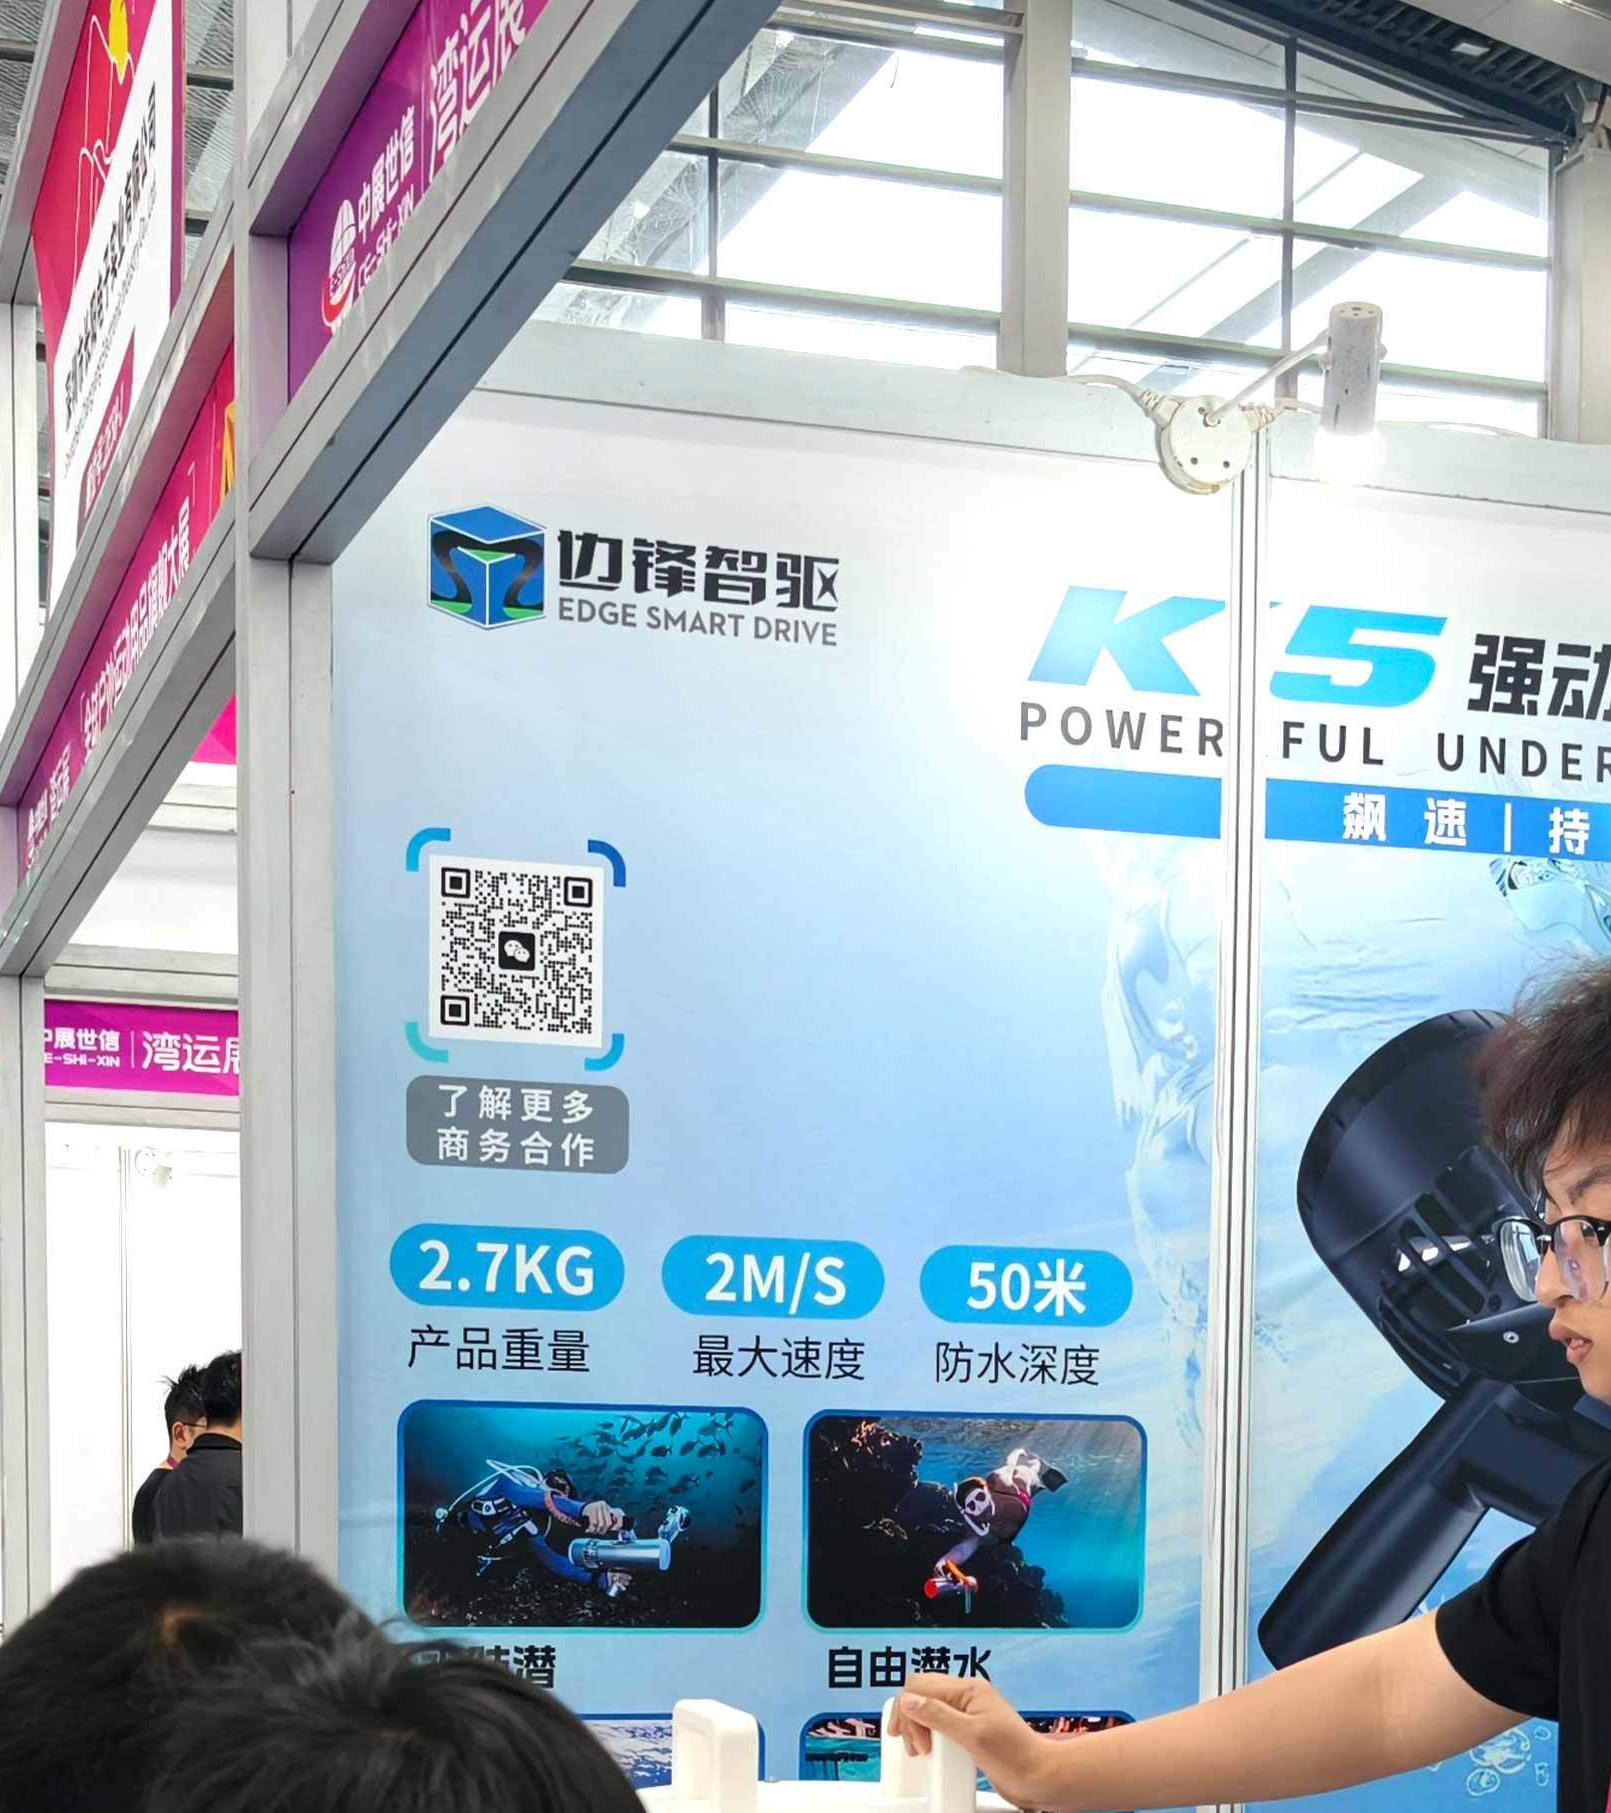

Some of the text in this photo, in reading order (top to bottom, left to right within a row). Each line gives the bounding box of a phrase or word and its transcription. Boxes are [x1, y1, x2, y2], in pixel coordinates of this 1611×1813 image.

[557, 597, 838, 647] EDGE SMART DRIVE
[437, 1083, 595, 1125] 了解更多
[435, 1125, 596, 1168] 商务合作
[417, 1239, 594, 1298] 2.7KG
[704, 1251, 849, 1315] 2M/S
[966, 1258, 1088, 1318] 50米
[407, 1325, 592, 1374] 产品重量
[691, 1335, 867, 1382] 最大速度
[934, 1341, 1101, 1388] 防水深度
